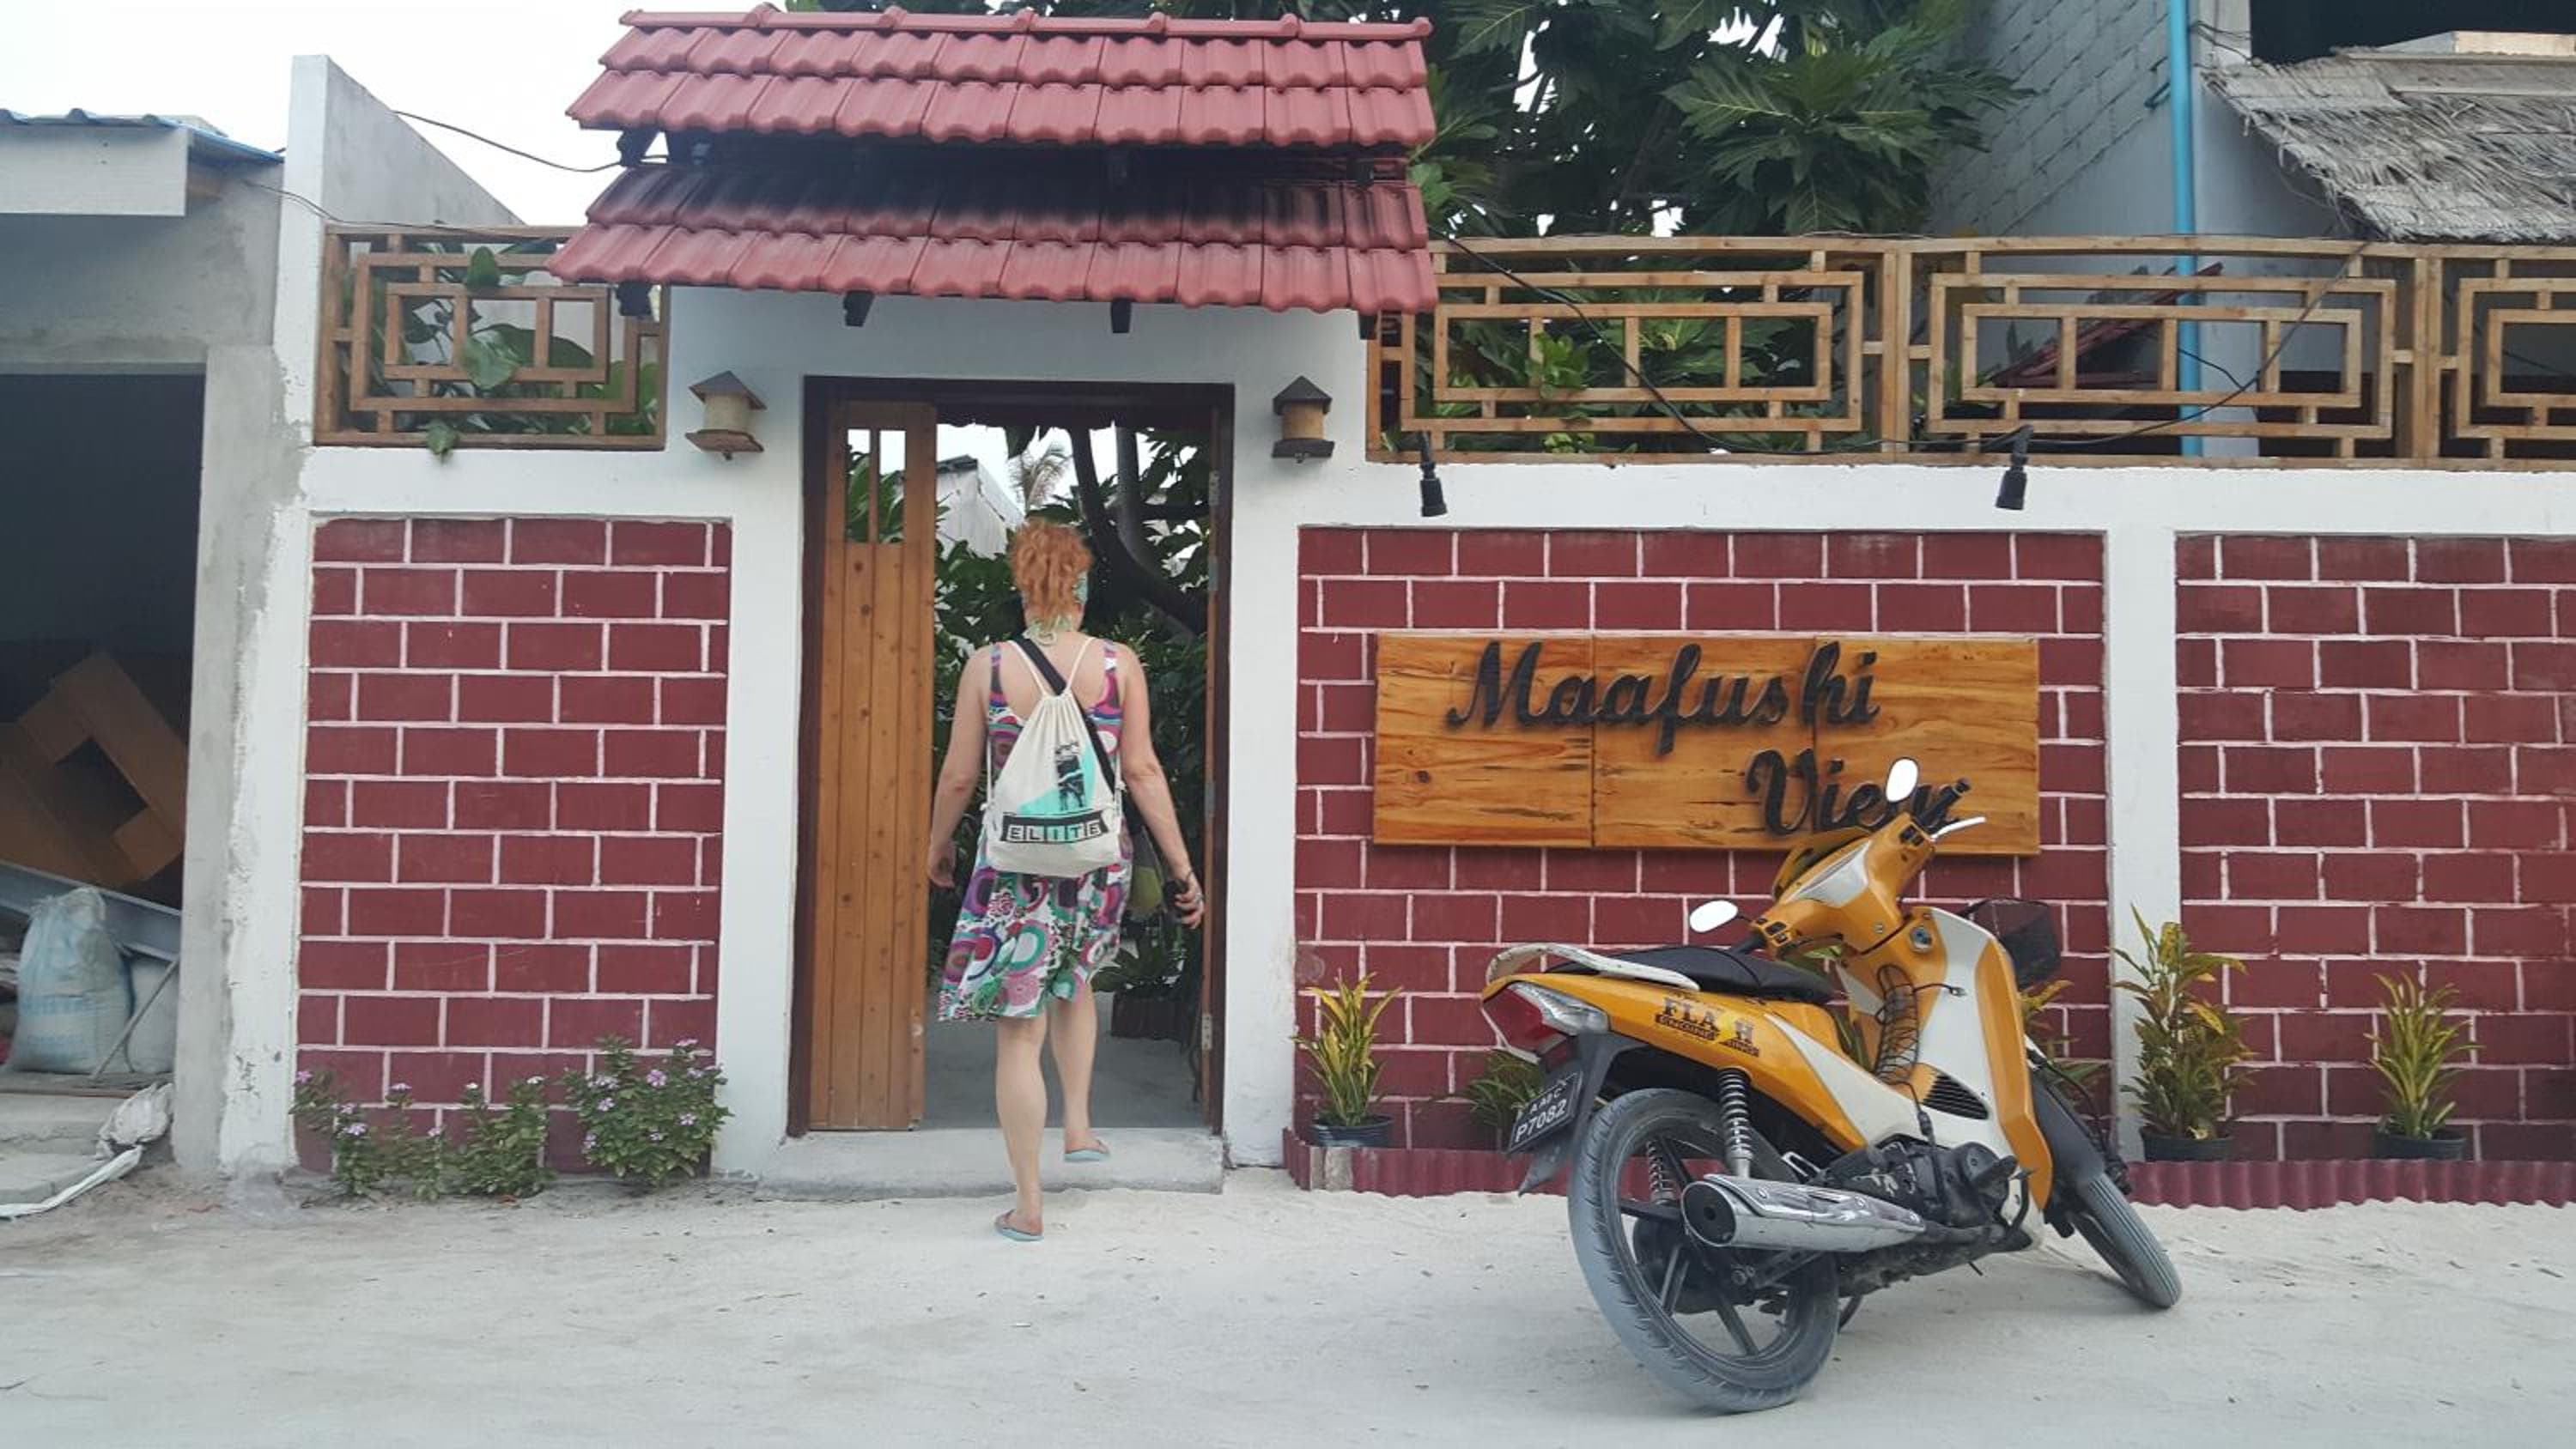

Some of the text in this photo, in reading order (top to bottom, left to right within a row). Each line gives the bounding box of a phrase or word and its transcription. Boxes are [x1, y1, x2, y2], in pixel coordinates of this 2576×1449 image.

[1446, 640, 1880, 755] Maafushi
[1009, 820, 1103, 841] ELITE
[1514, 1098, 1568, 1143] P7082
